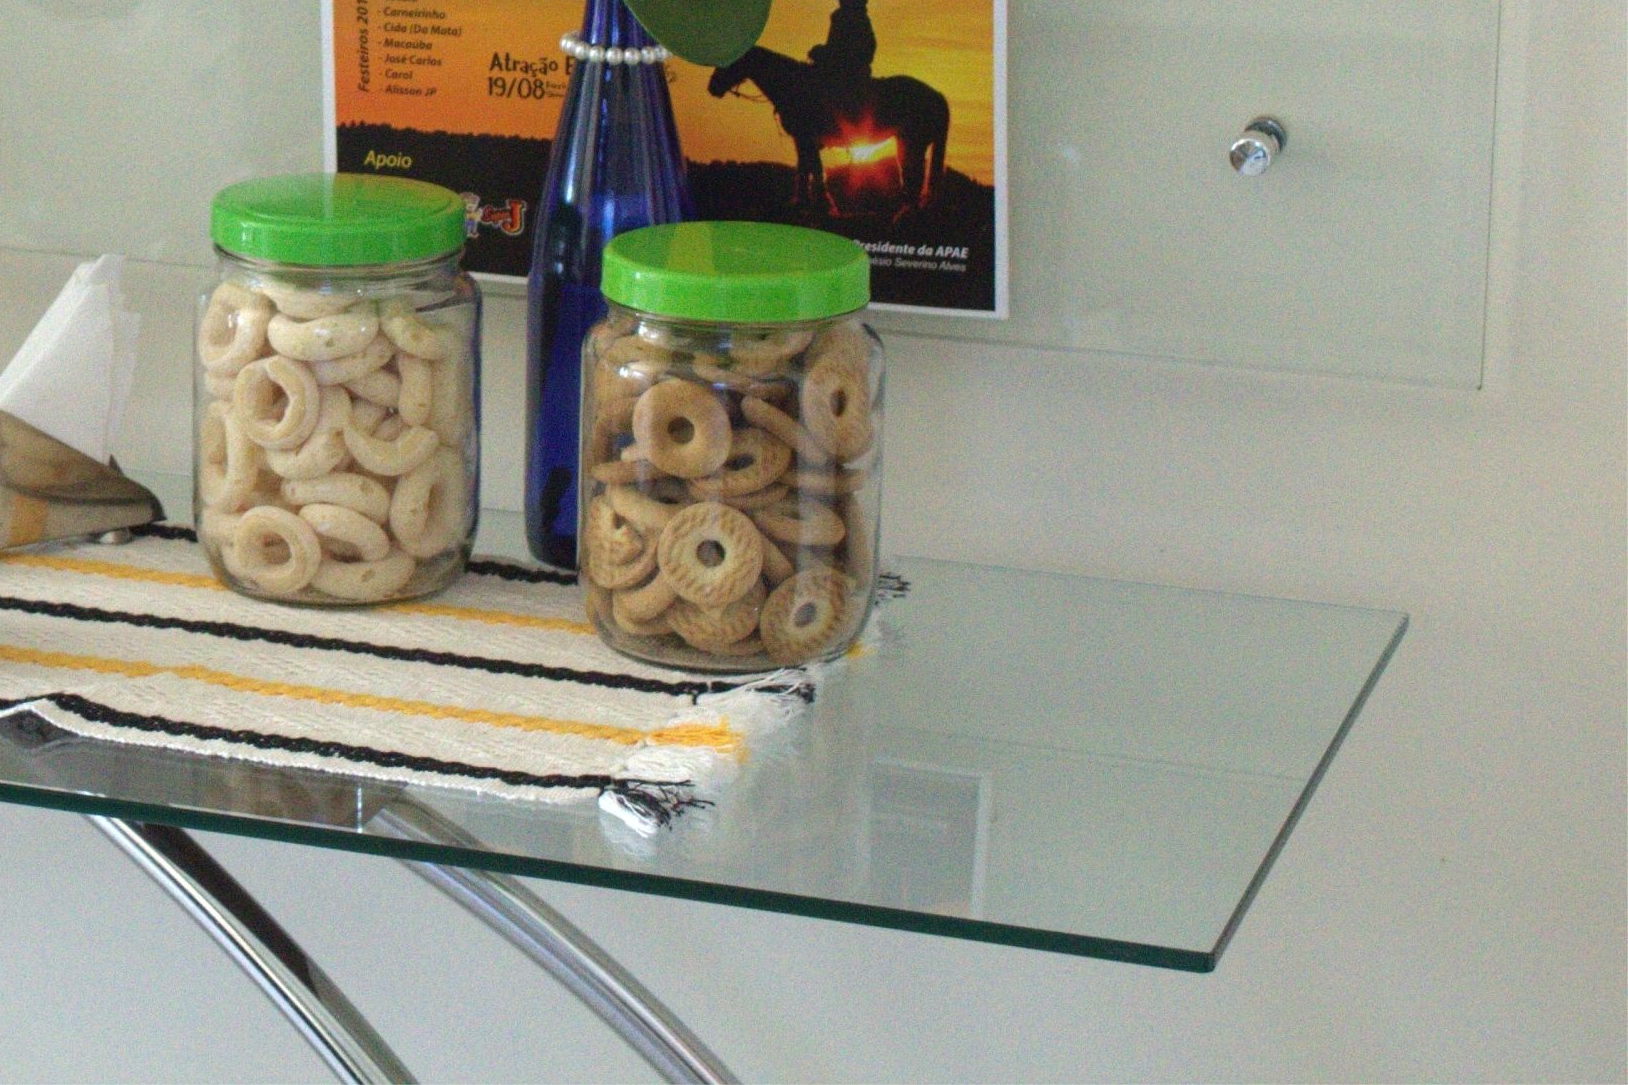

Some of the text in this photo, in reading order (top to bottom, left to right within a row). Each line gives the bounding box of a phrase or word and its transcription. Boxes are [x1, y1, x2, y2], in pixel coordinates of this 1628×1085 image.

[357, 28, 371, 93] Festeiros
[489, 52, 559, 78] Atração
[487, 76, 546, 100] 19/08
[364, 148, 412, 170] Apoio
[934, 245, 970, 259] APAE
